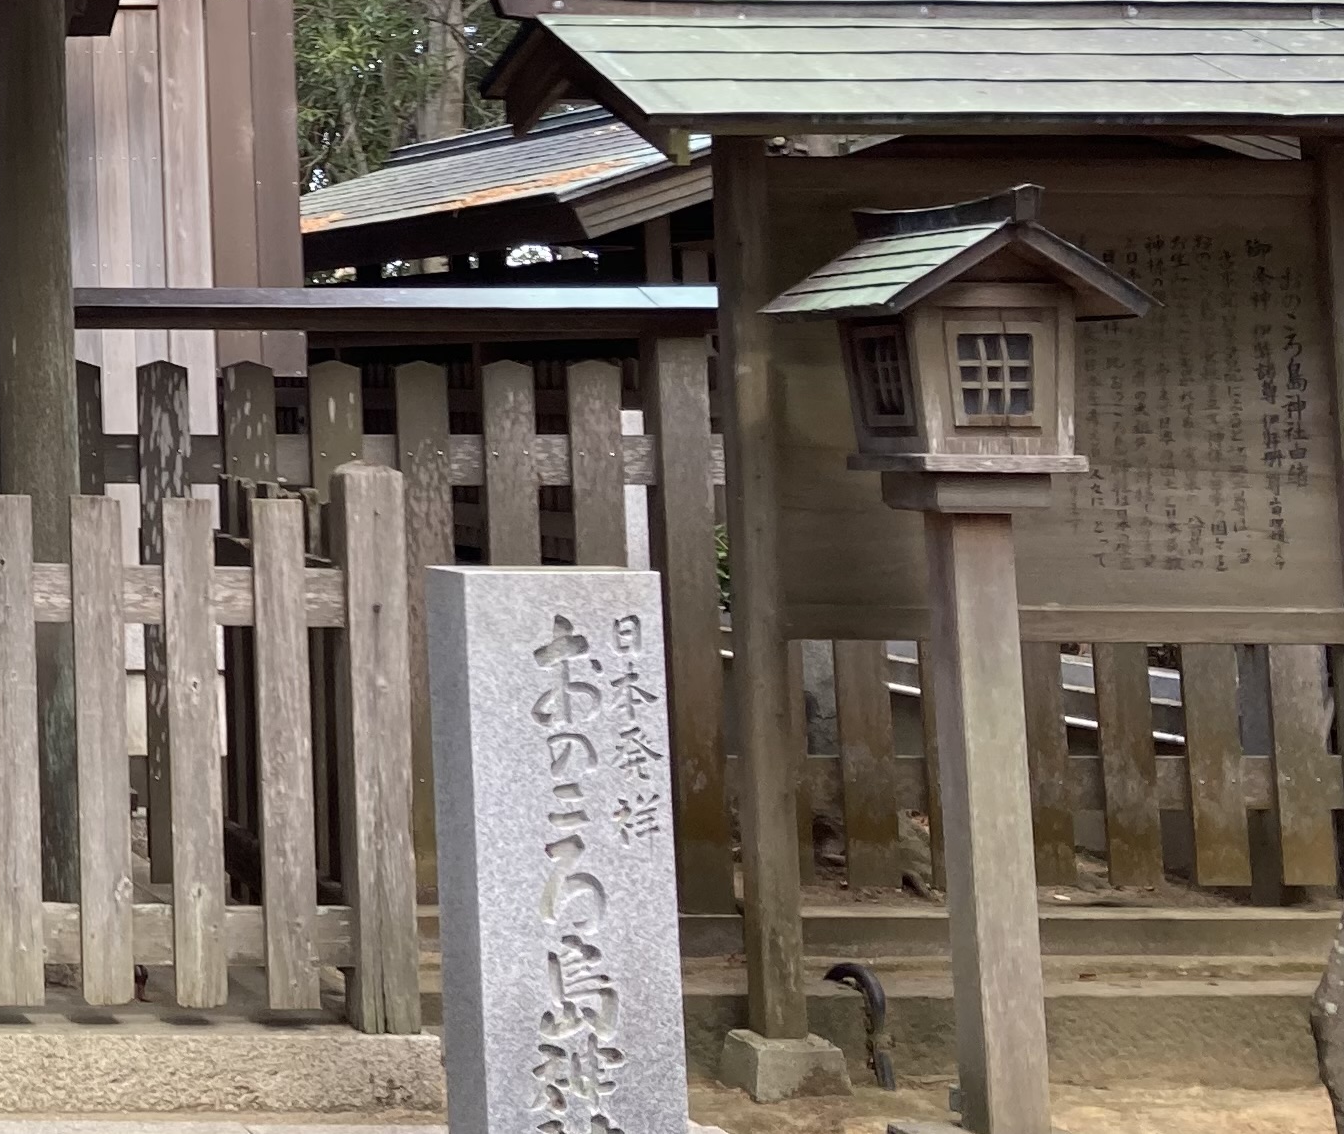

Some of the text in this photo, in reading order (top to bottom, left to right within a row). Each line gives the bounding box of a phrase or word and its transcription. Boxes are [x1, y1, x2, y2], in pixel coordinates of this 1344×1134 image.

[530, 614, 627, 1134] おのころ島神
[611, 614, 665, 848] 日本発祥
